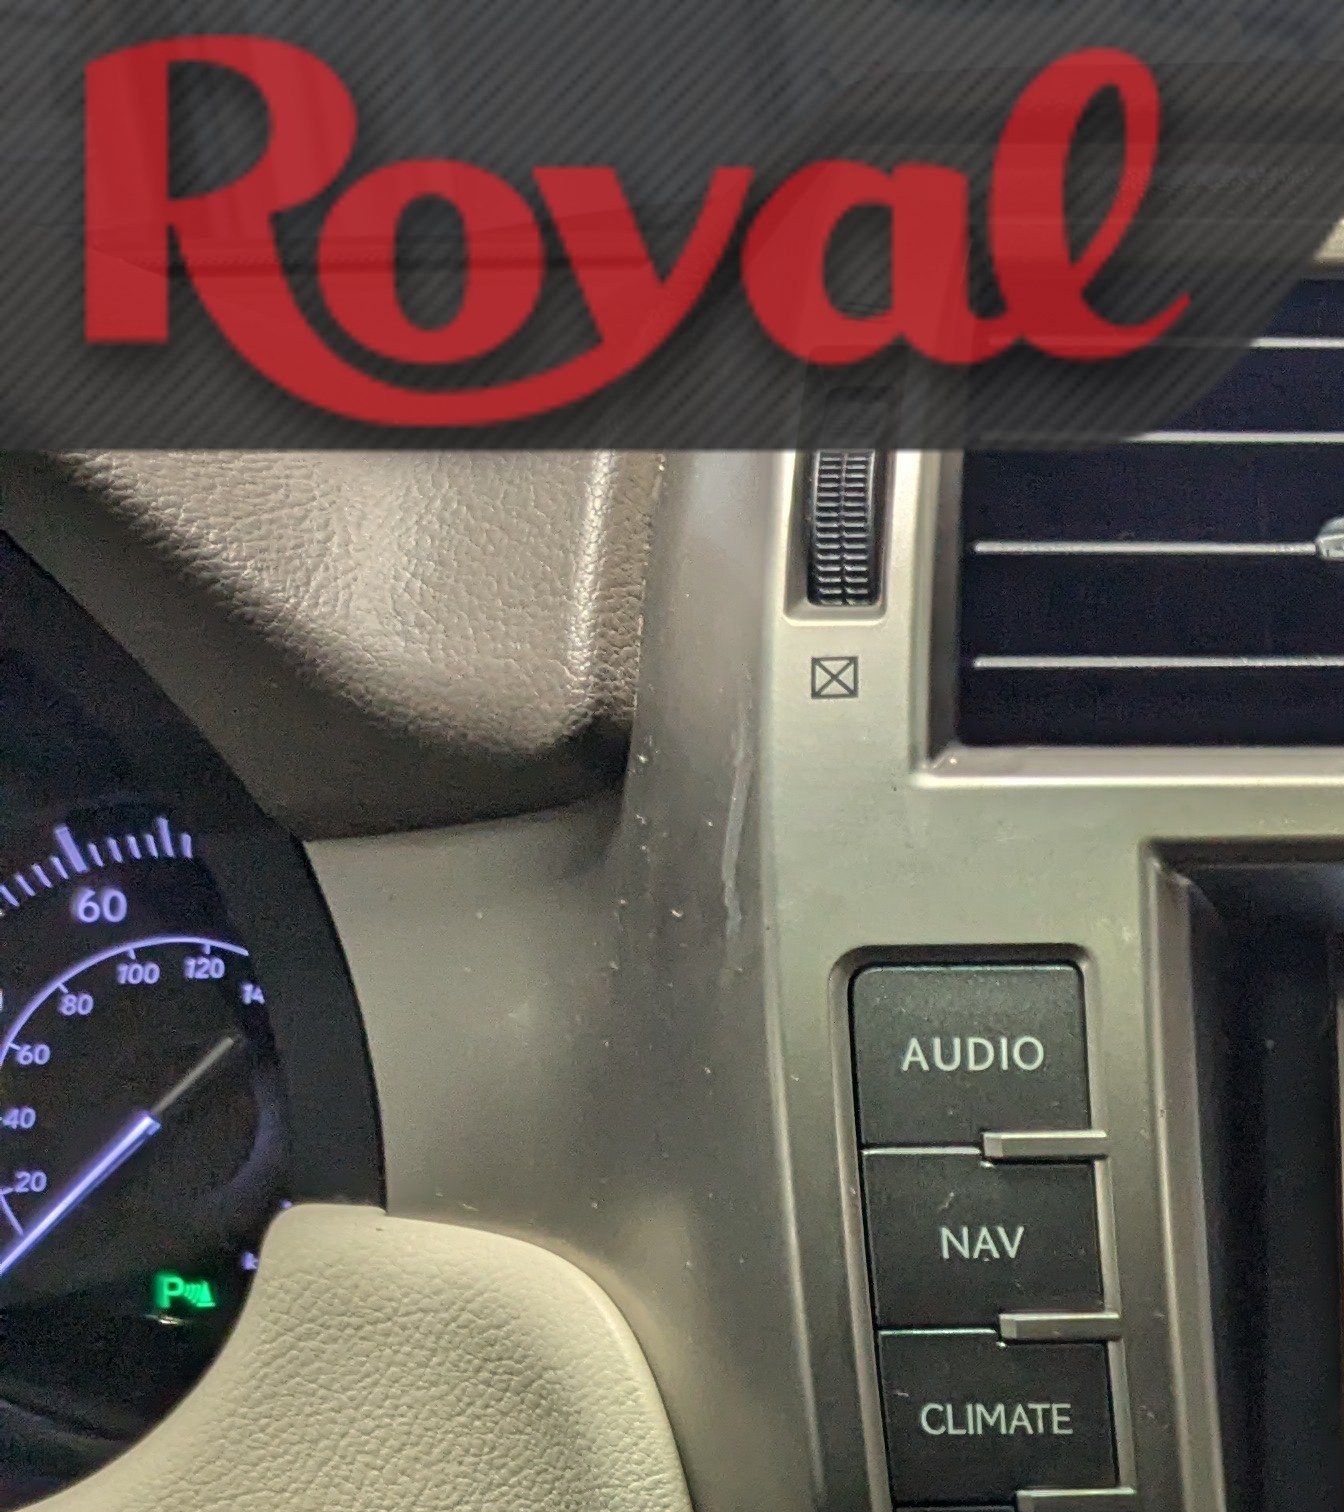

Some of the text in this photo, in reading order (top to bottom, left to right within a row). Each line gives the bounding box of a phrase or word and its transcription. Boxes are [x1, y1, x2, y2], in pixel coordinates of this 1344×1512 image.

[75, 887, 127, 924] 60
[117, 962, 160, 985] 100
[184, 957, 225, 980] 120
[59, 993, 93, 1016] 80
[16, 1044, 50, 1066] 60
[902, 1036, 1045, 1072] AUDIO
[3, 1106, 36, 1129] 40
[14, 1171, 47, 1193] 20
[940, 1226, 1025, 1260] NAV
[921, 1403, 1074, 1436] CLIMATE
